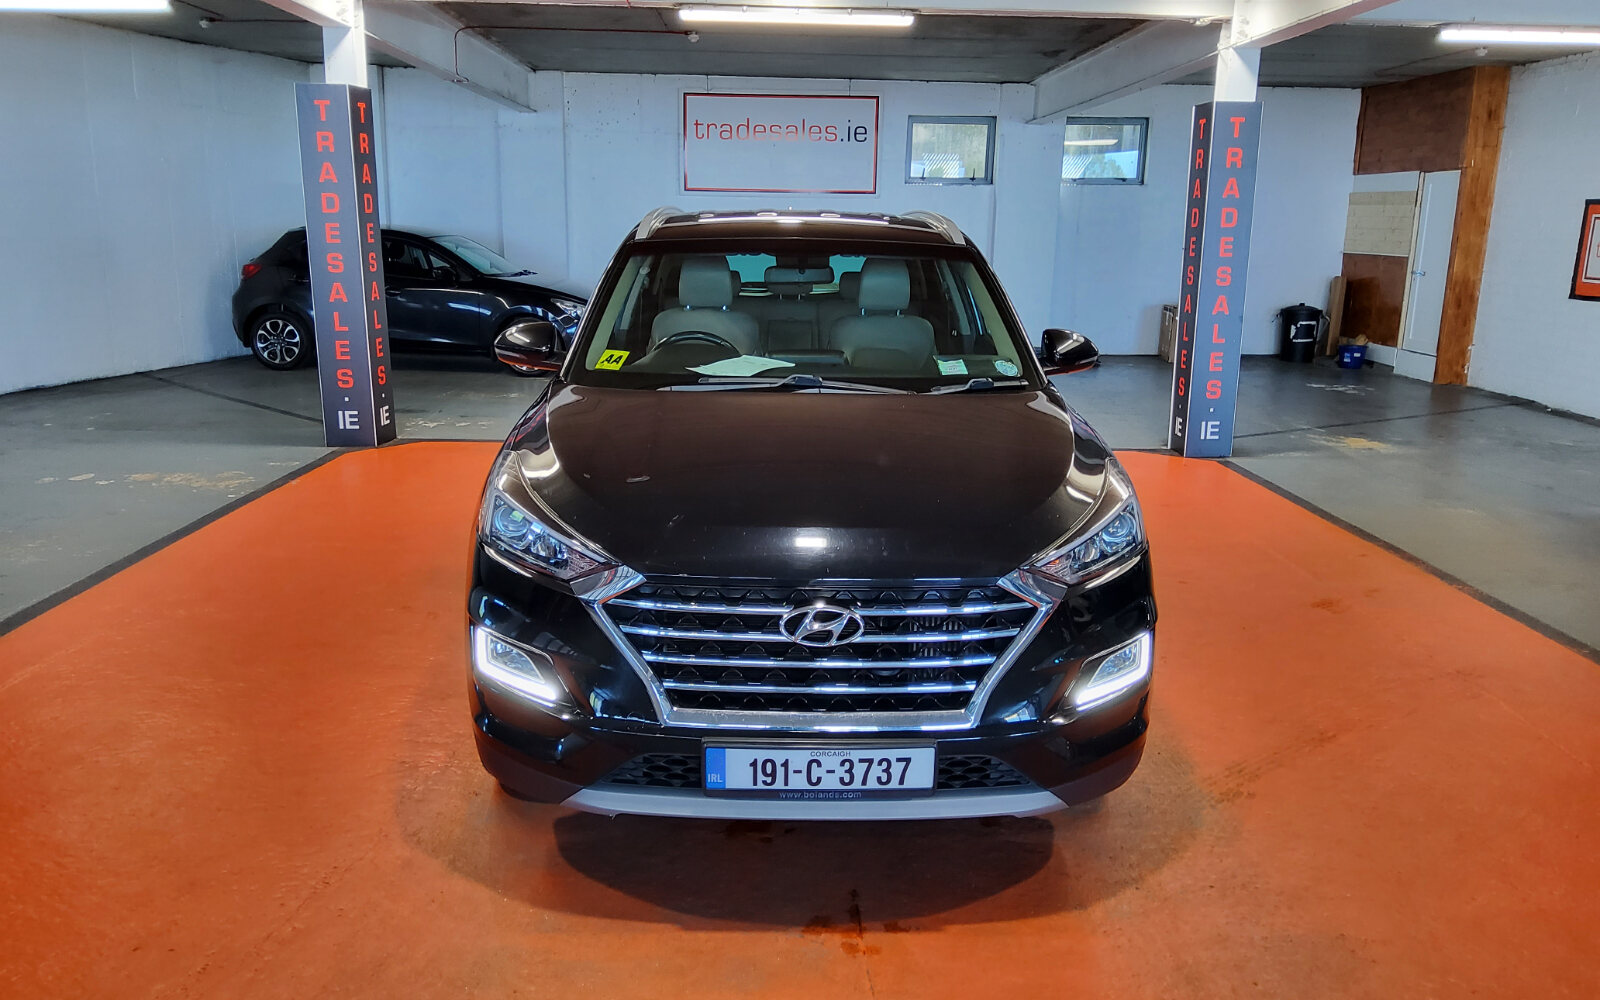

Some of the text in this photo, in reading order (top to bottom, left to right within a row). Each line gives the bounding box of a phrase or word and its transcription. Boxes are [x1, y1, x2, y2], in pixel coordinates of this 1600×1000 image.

[693, 117, 868, 143] tradesales.ie
[600, 354, 624, 365] AA
[809, 750, 851, 758] CORCAIGH
[748, 756, 912, 788] 191-C-3737
[707, 773, 724, 784] IRL
[779, 790, 862, 800] www.bolands.com
